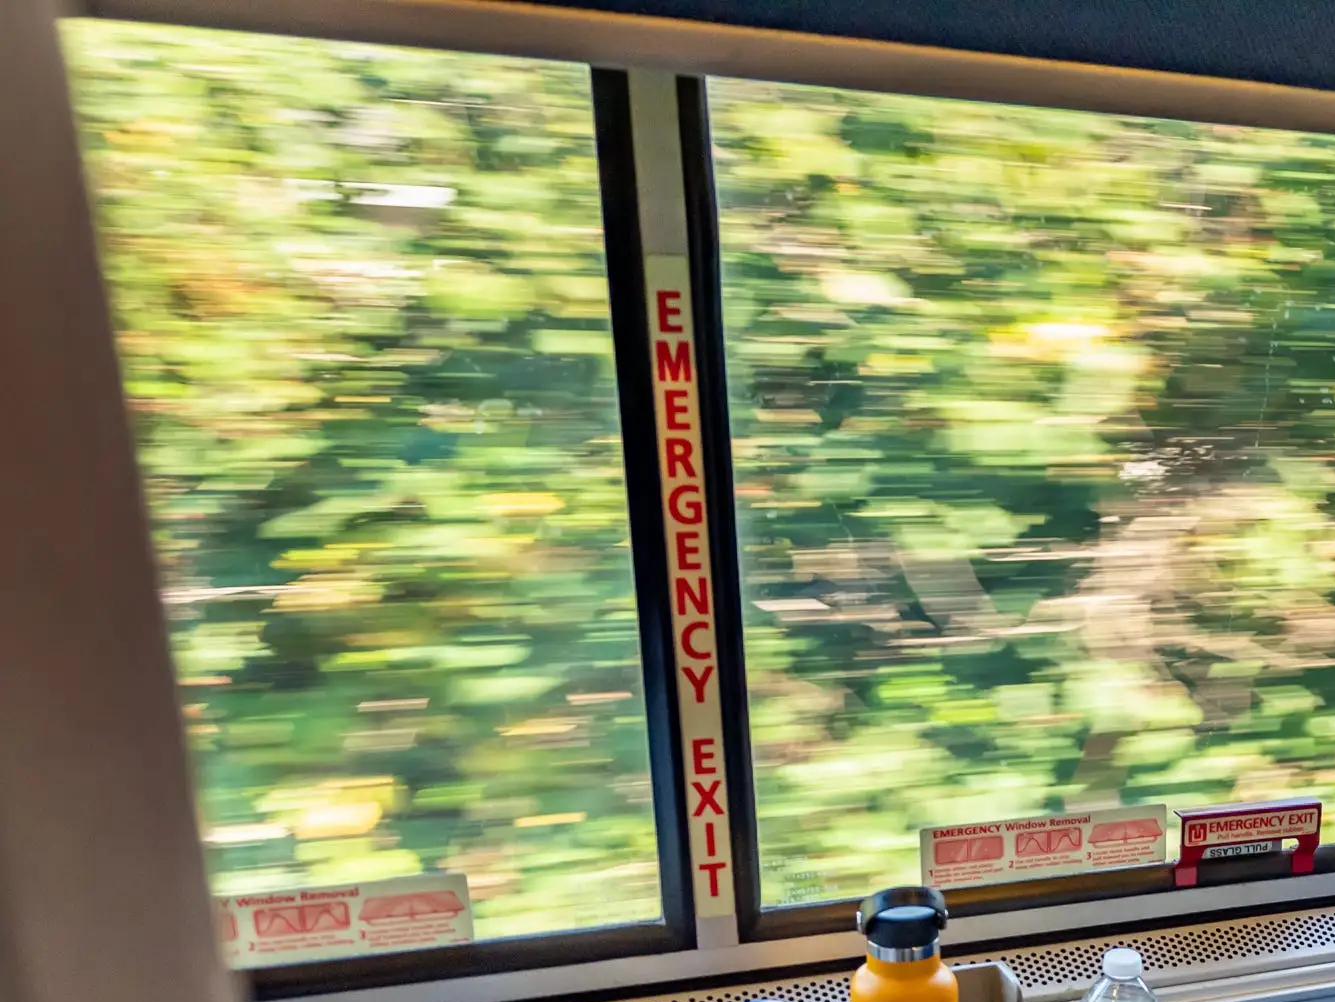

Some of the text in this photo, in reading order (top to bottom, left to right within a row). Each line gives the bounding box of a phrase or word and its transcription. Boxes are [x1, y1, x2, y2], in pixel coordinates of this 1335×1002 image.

[656, 290, 727, 897] EMERGENCY EXIT
[932, 815, 1091, 839] EMERGENCY Window Removal
[1208, 812, 1315, 833] EMERGENCY EXIT
[1209, 843, 1268, 857] PULL GLASS
[300, 887, 359, 901] Removal
